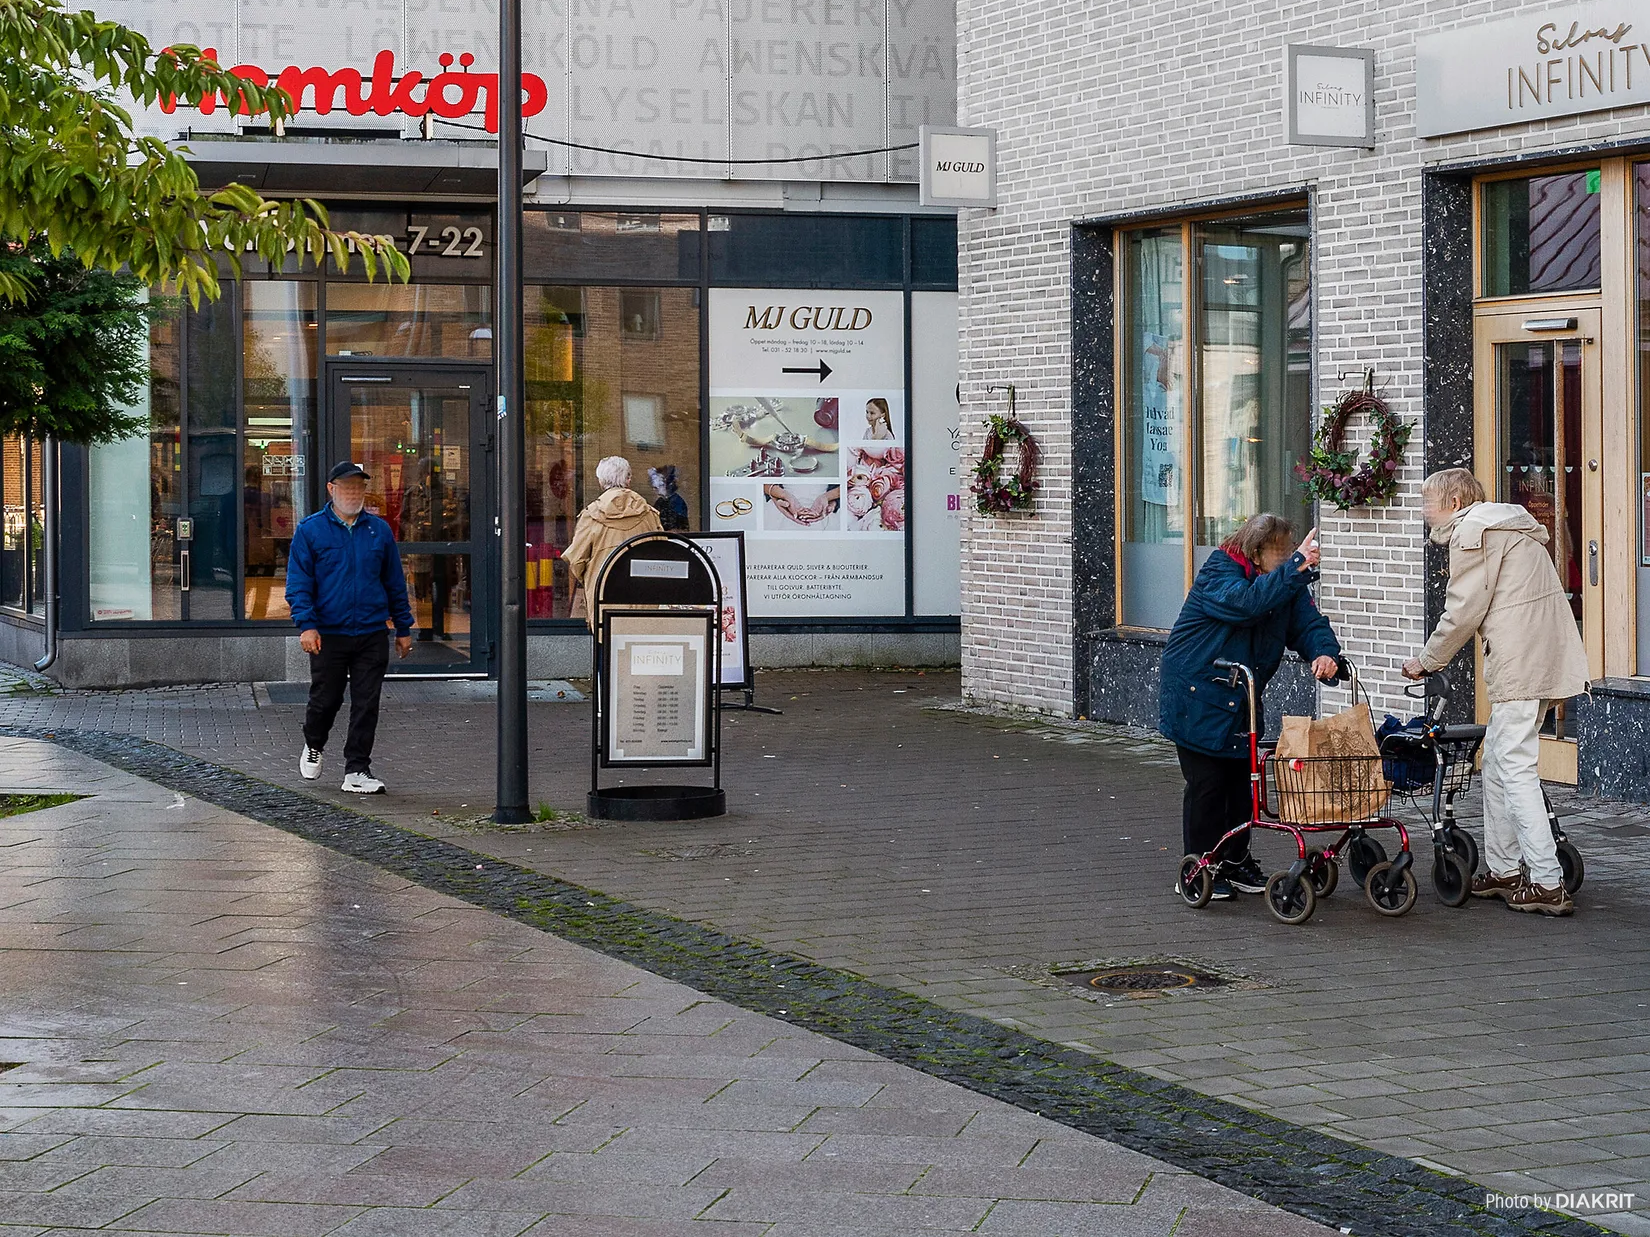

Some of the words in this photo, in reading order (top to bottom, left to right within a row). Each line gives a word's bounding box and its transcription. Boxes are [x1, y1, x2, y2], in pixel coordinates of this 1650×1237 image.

[1300, 91, 1361, 106] INFINITY
[936, 161, 952, 172] MJ
[953, 162, 984, 173] GULD
[407, 226, 484, 256] 7-22
[743, 306, 786, 330] MJ
[789, 306, 873, 330] GULD
[644, 564, 675, 573] INFINITY
[824, 573, 840, 581] FRÅN
[633, 654, 681, 666] INFINITY
